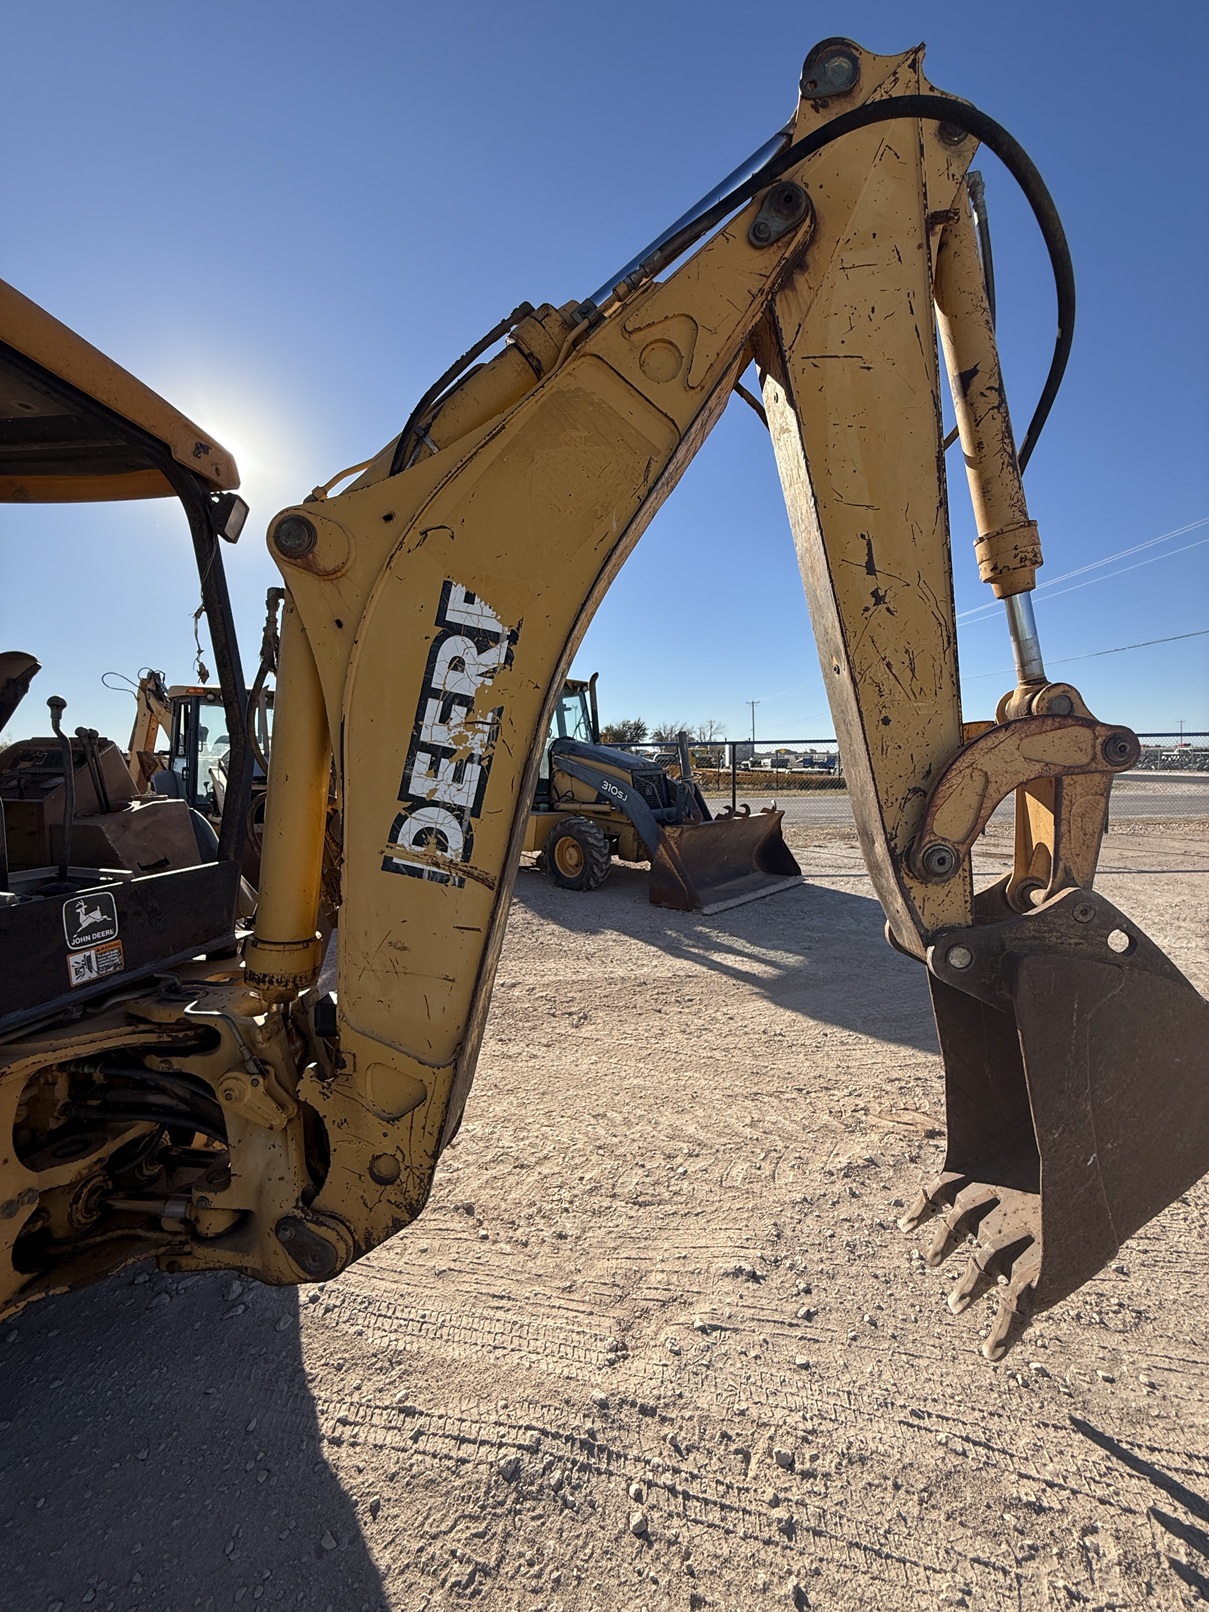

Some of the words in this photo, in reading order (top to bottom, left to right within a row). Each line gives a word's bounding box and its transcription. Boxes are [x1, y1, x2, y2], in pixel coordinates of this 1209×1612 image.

[601, 780, 628, 801] 310SJ
[71, 935, 91, 946] JOHN
[92, 929, 114, 940] DEERE
